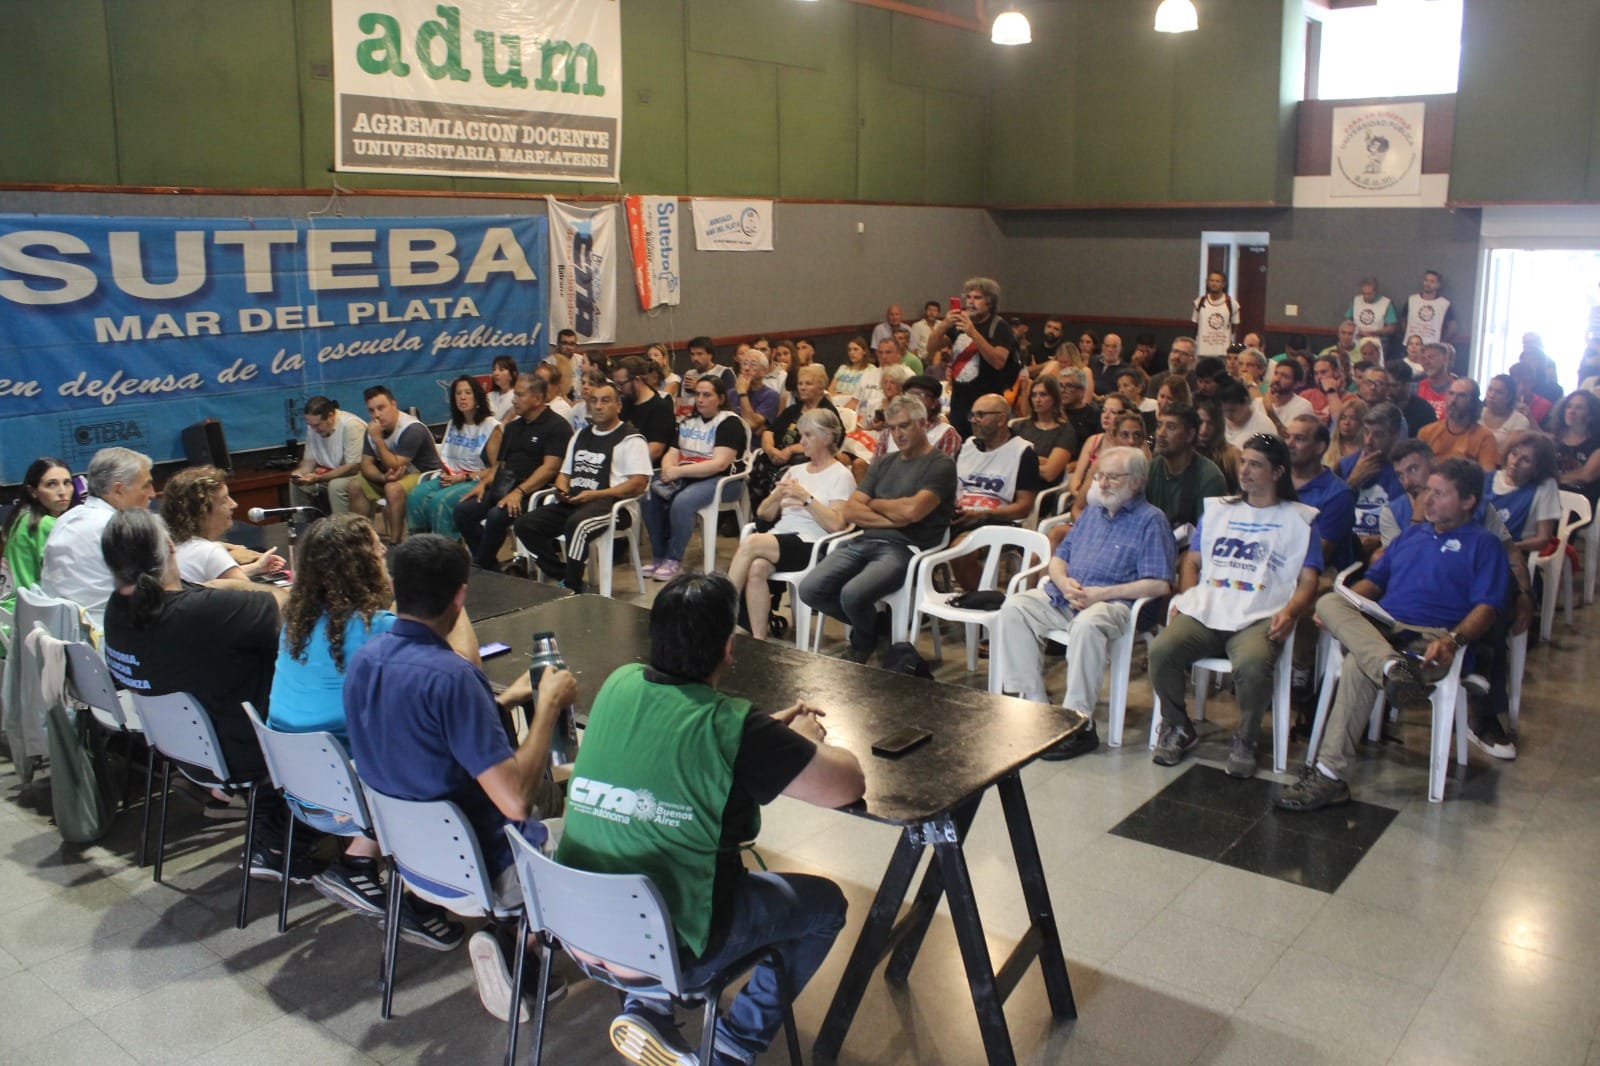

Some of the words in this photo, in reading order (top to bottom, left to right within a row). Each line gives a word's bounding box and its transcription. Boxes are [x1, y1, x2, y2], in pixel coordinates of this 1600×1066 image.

[356, 4, 606, 97] adum
[352, 112, 518, 144] AGREMIACION
[520, 124, 610, 149] DOCENTE
[353, 138, 497, 161] UNIVERSITARIA
[499, 147, 609, 168] MARPLATENSE
[656, 201, 676, 270] Suteba
[0, 228, 537, 305] SUTEBA
[573, 231, 593, 338] CTA
[94, 309, 221, 343] MAR
[238, 305, 335, 333] DEL
[347, 296, 481, 325] PLATA
[0, 378, 42, 398] en
[57, 368, 205, 406] defensa
[217, 361, 260, 385] de
[271, 347, 305, 374] la
[317, 328, 425, 362] escuela
[430, 323, 543, 355] pública!
[74, 421, 144, 445] CTERA
[570, 777, 636, 816] CTA
[656, 806, 693, 820] Buenos
[654, 815, 680, 827] Aires
